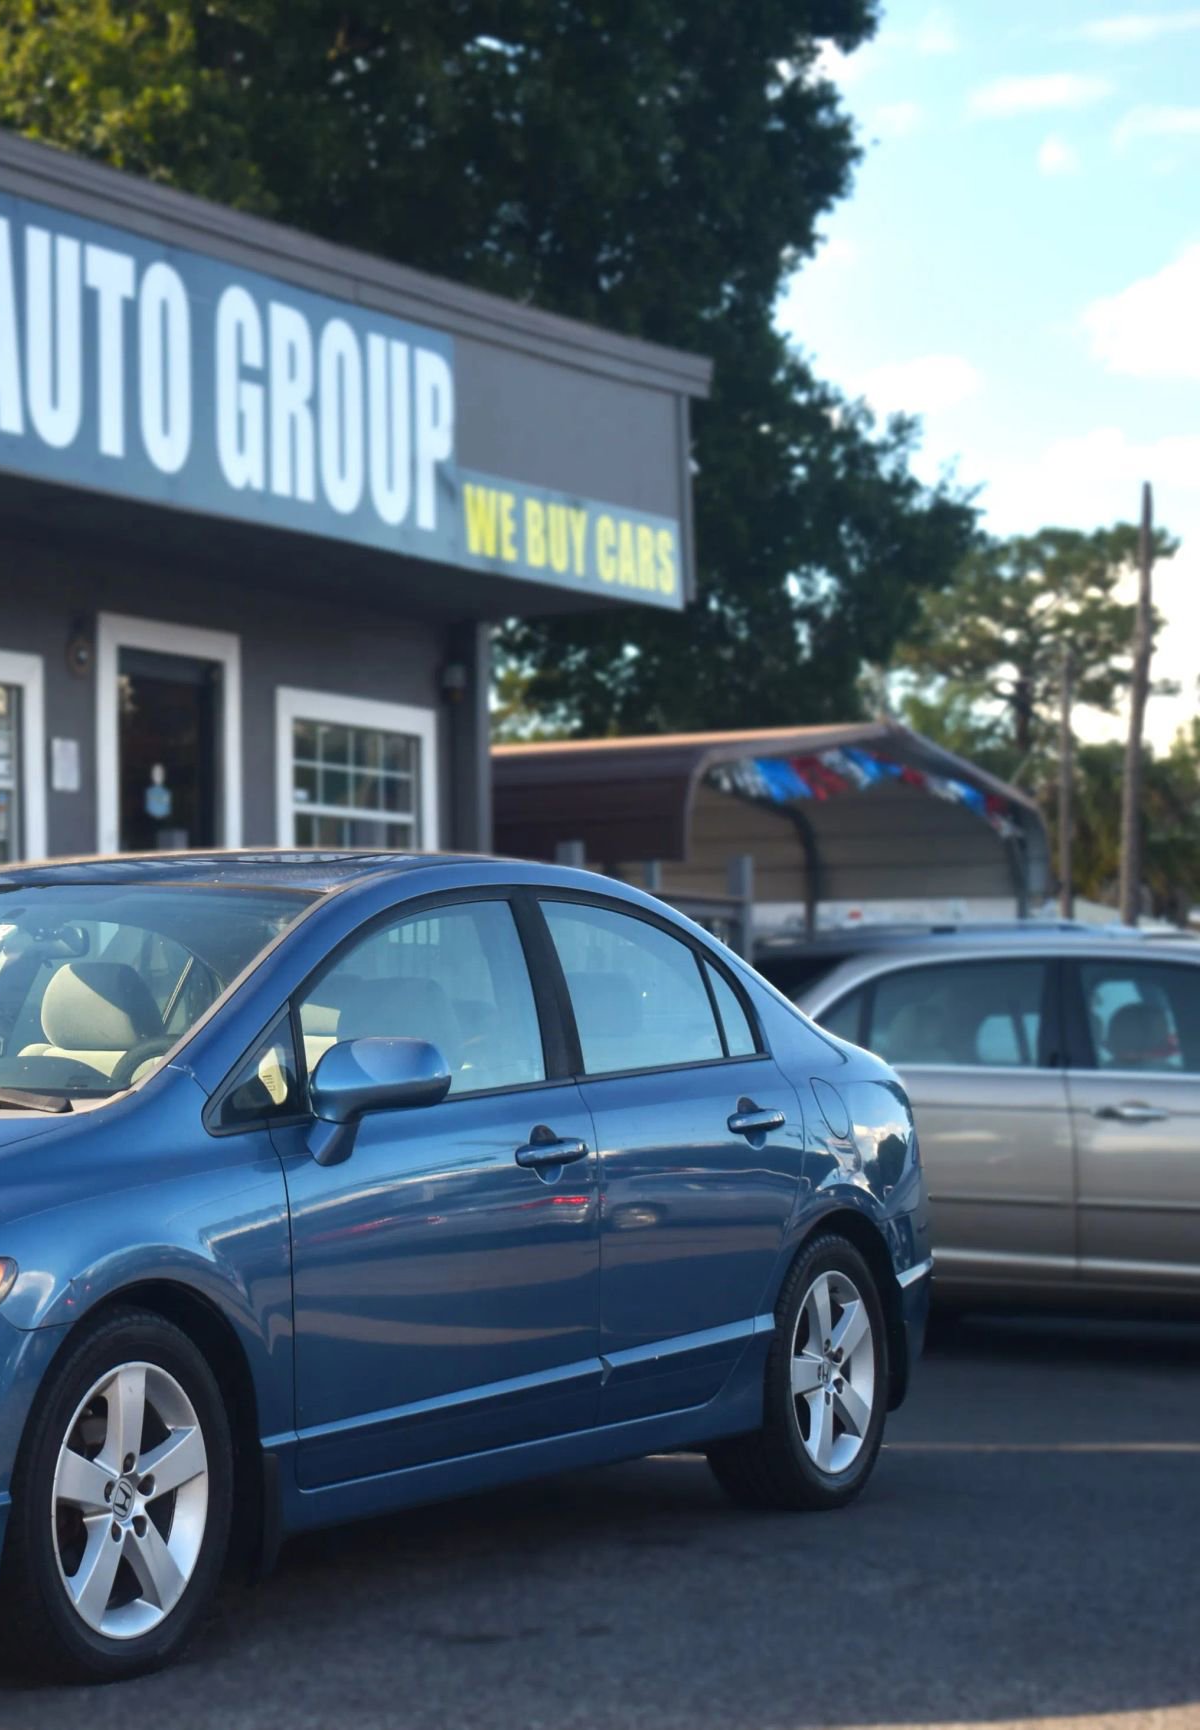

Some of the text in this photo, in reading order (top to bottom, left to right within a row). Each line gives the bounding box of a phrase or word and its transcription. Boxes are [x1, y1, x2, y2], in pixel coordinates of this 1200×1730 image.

[215, 285, 455, 533] GROUP
[463, 483, 676, 595] WE BUY CARS
